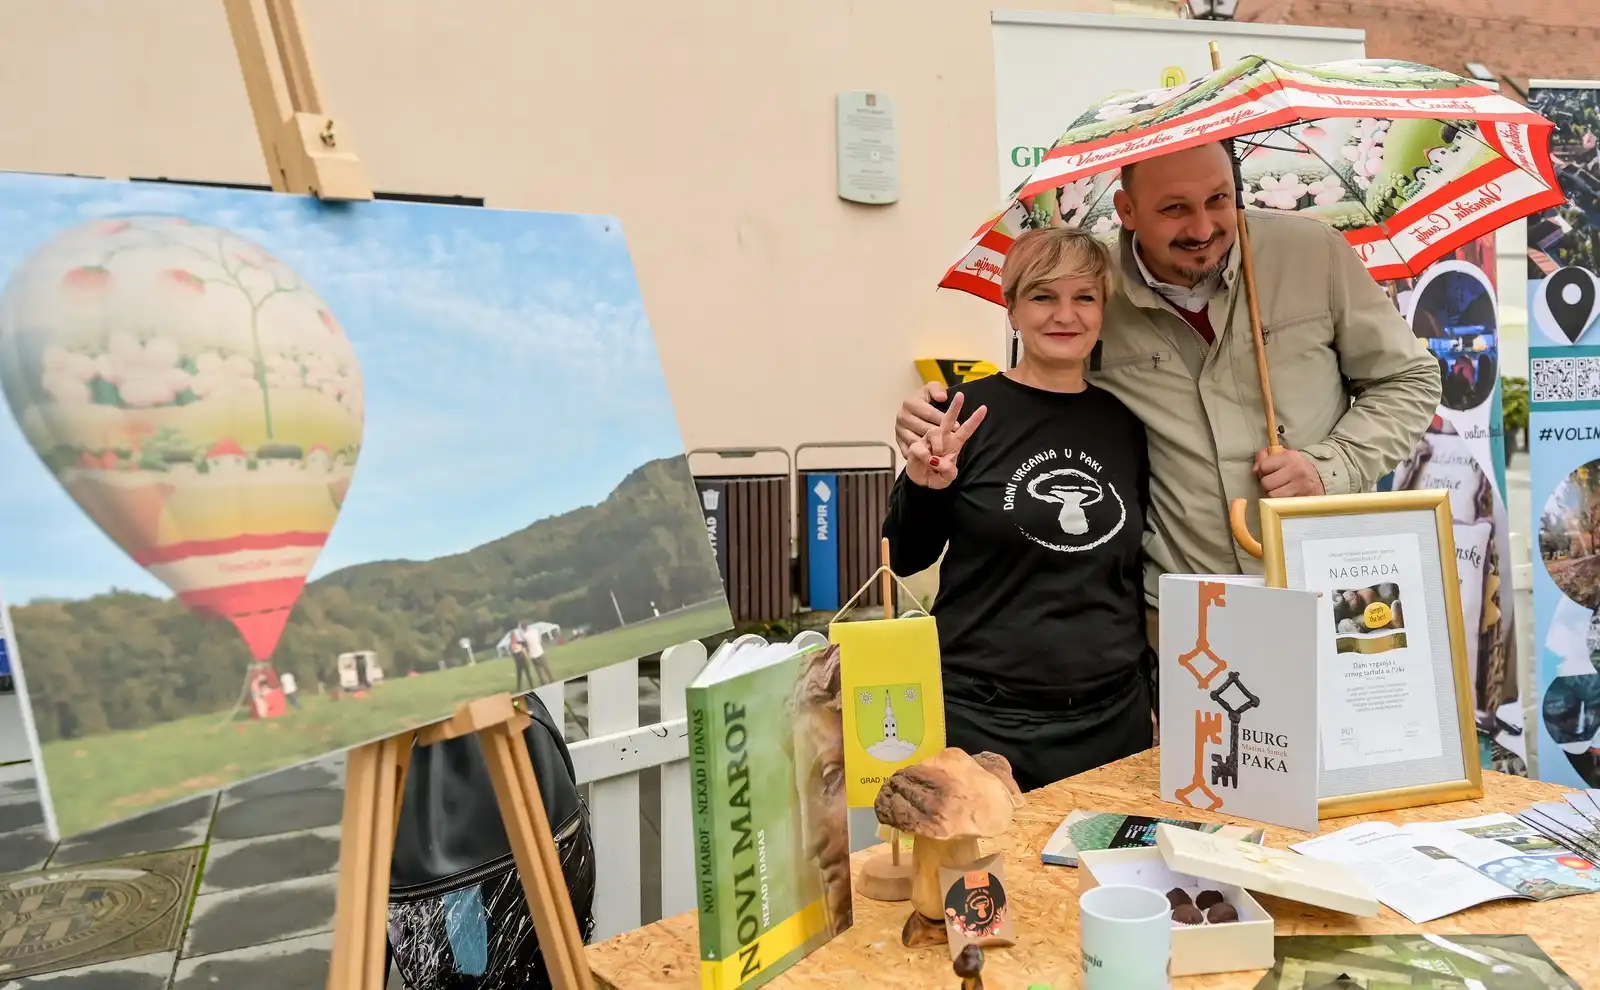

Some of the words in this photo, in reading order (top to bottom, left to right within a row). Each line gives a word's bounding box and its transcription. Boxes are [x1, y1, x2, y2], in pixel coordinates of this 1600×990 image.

[1003, 482, 1018, 511] DANI
[1012, 449, 1057, 482] VRGANJA
[1064, 448, 1072, 459] U
[1079, 452, 1103, 473] PAKI
[706, 516, 718, 557] PAD
[816, 504, 829, 541] PAPIR
[1329, 563, 1399, 579] NAGRADA
[1456, 545, 1481, 569] nske
[692, 709, 706, 756] DANAS
[1241, 728, 1288, 748] BURG
[723, 700, 753, 859] MAROF
[860, 776, 881, 784] GRAD
[1241, 752, 1288, 773] PAKA
[696, 768, 709, 815] NEKAD
[698, 827, 713, 876] MAROF
[757, 829, 768, 874] DANAS
[702, 880, 715, 914] NOVI
[760, 883, 771, 928] NEKAD
[733, 863, 761, 982] NOVI
